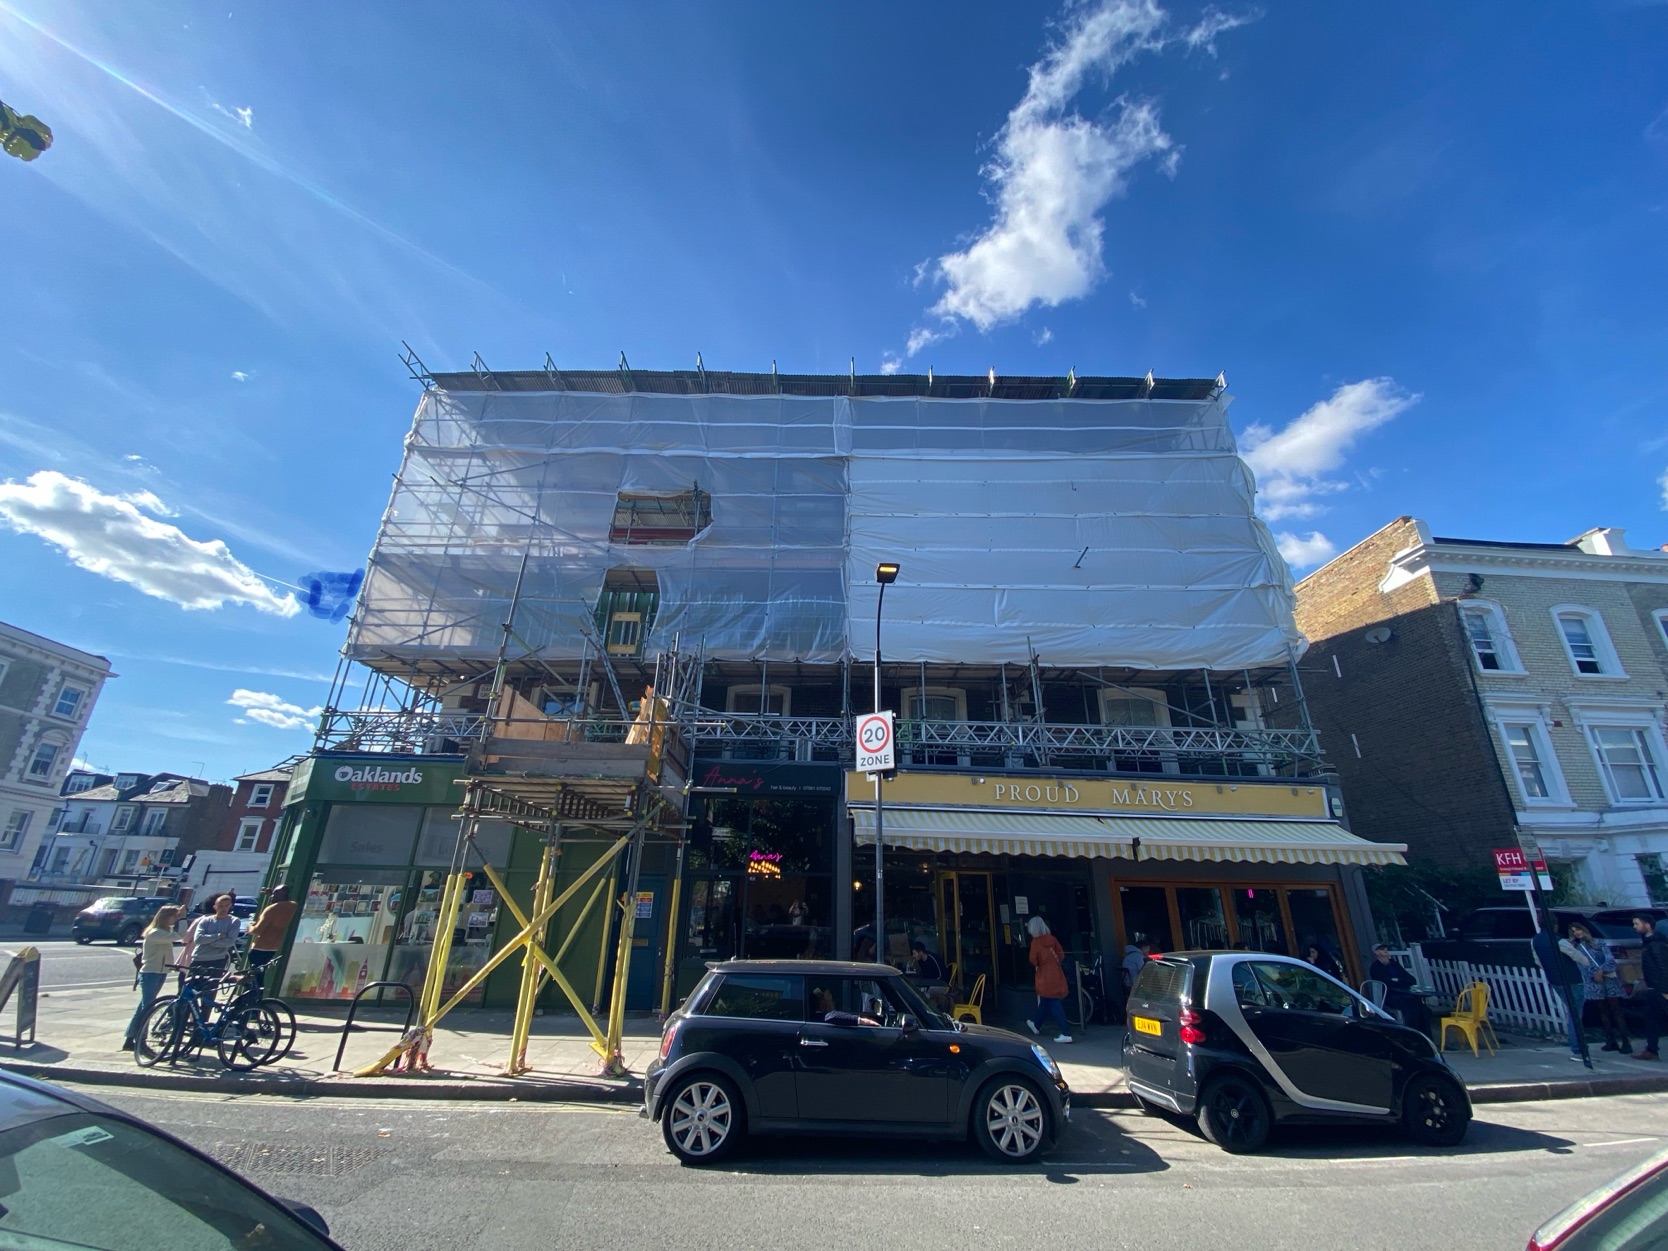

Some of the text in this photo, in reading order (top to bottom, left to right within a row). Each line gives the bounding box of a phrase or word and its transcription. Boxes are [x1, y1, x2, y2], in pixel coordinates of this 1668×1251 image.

[864, 726, 885, 743] 20
[860, 754, 890, 767] ZONE
[334, 765, 424, 785] Oaklands
[351, 783, 400, 791] ESTATES
[994, 783, 1193, 811] PROUD MARY'S
[349, 840, 385, 854] Sales
[1495, 852, 1522, 865] KFH
